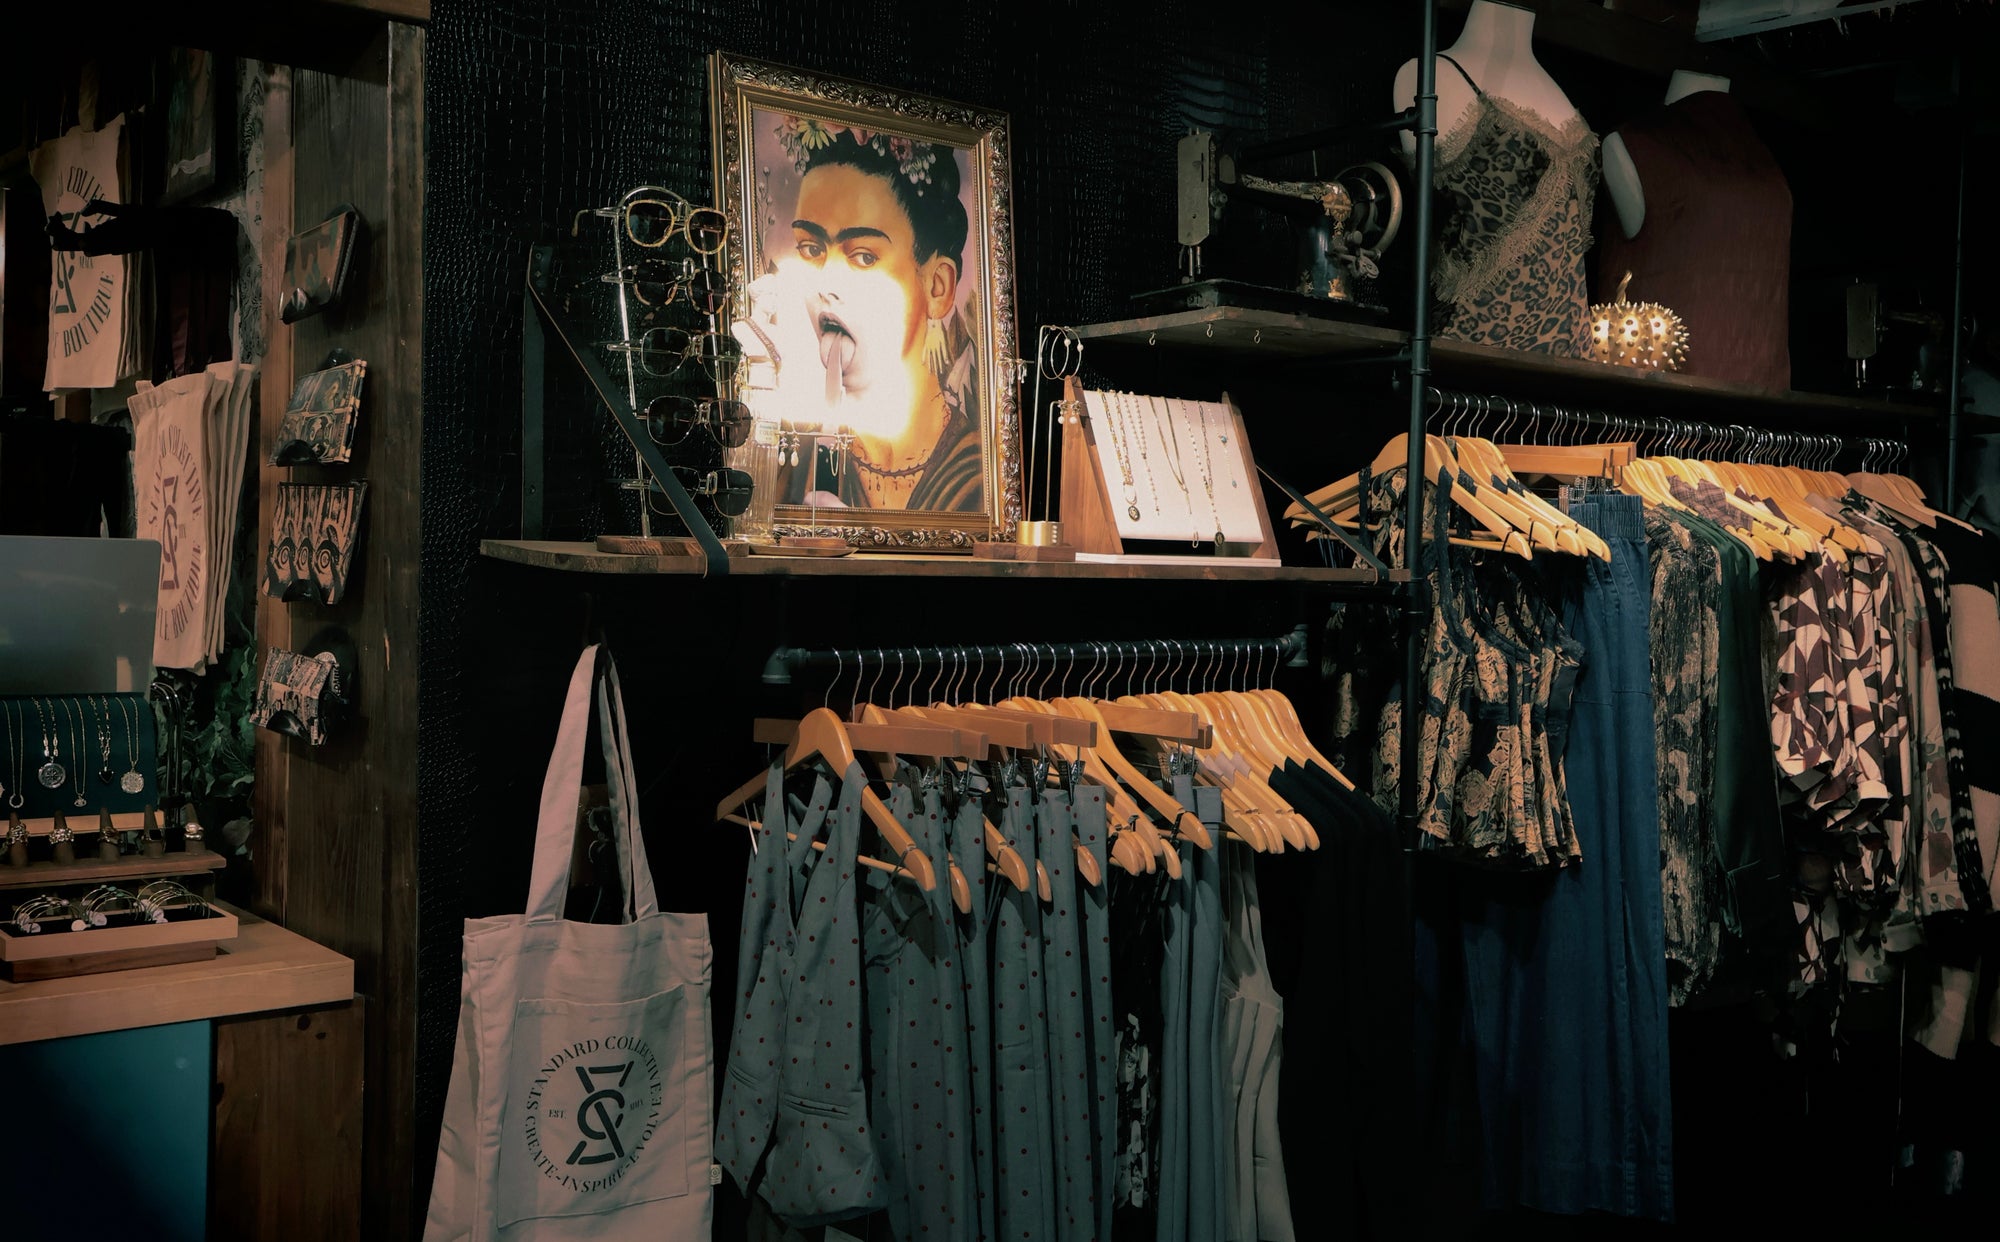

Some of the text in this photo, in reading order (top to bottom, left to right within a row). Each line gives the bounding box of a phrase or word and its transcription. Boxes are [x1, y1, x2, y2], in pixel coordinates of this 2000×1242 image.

[63, 270, 115, 359] BOUTIQUE
[526, 1035, 663, 1111] STANDARD COLLECTIVE
